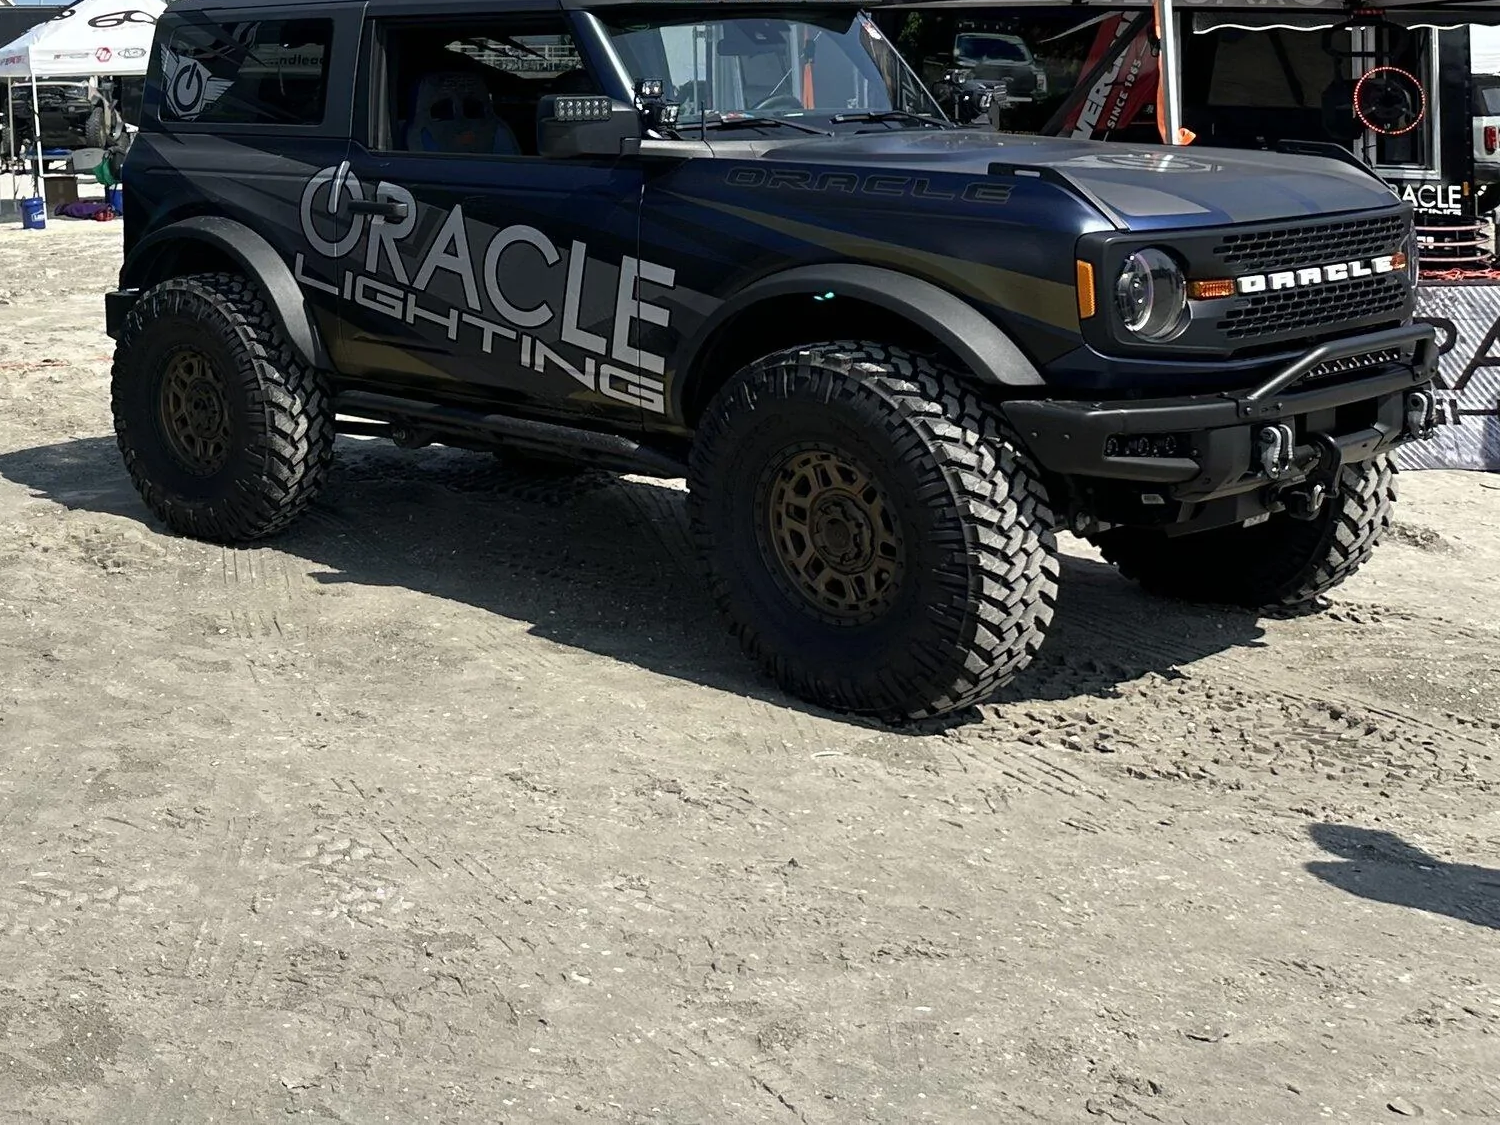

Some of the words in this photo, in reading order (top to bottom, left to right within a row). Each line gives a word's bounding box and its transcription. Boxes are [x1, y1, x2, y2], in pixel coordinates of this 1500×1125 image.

[1107, 91, 1128, 129] SINCE
[1125, 59, 1141, 87] 1965
[723, 166, 1016, 204] ORACLE
[300, 161, 676, 376] ORACLE
[1237, 256, 1396, 293] ORACLE
[295, 252, 665, 415] LIGHTING
